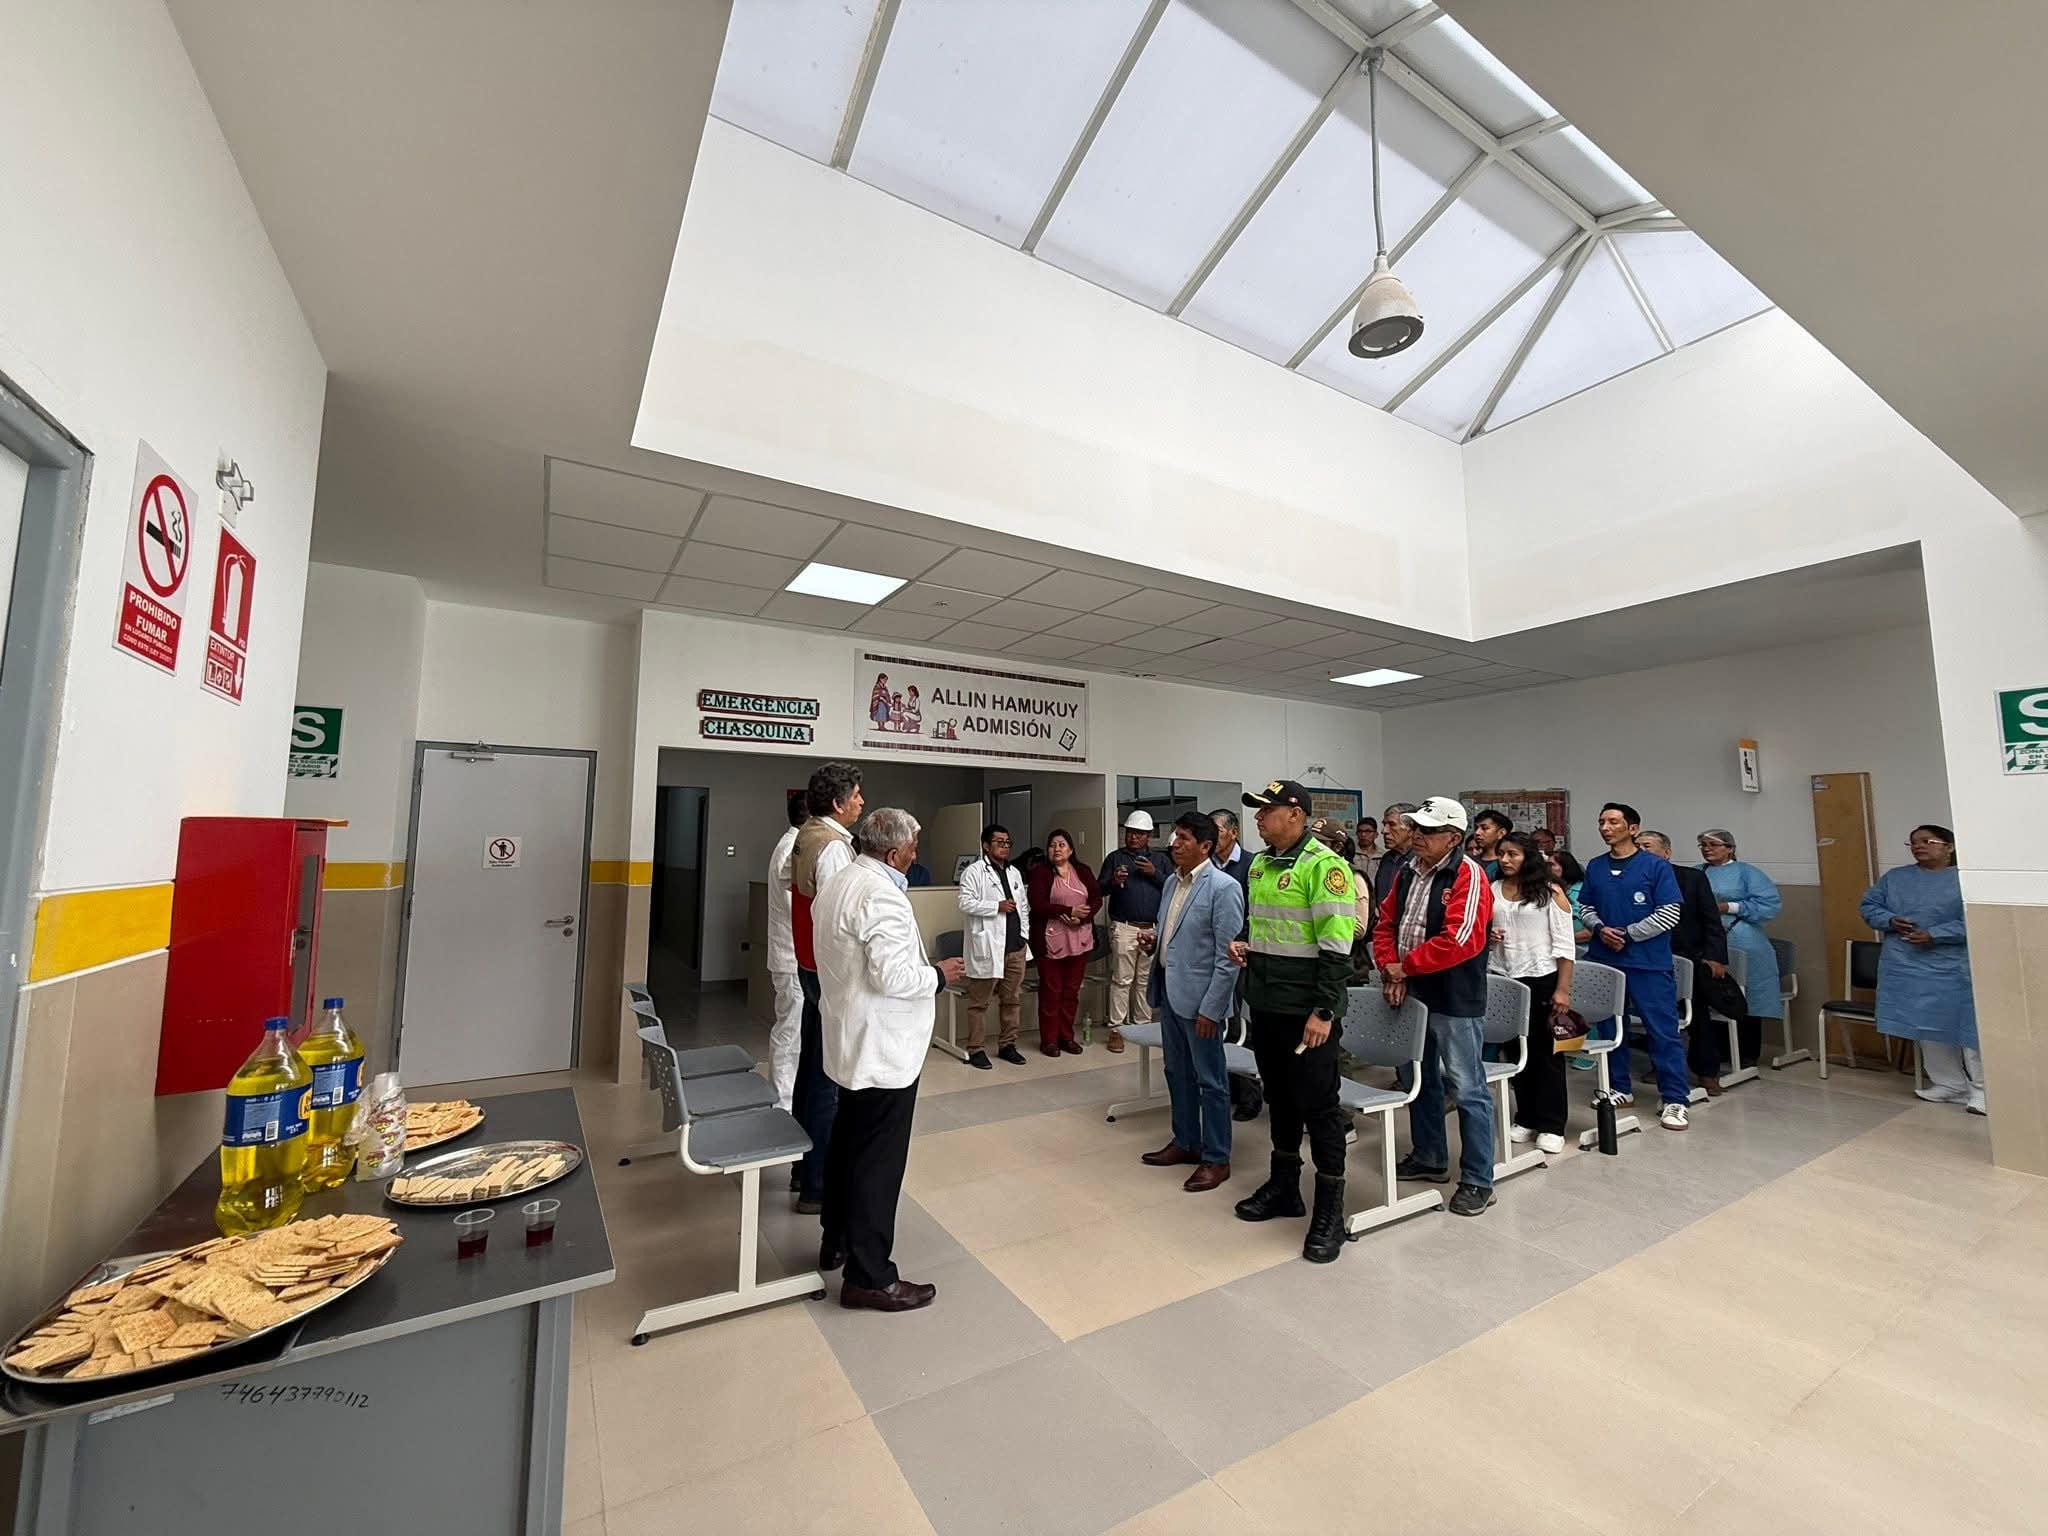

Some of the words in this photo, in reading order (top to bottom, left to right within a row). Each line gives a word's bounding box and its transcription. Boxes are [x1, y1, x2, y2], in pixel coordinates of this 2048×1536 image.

[129, 590, 178, 630] PROHIBIDO
[135, 614, 168, 643] FUMAR
[703, 693, 815, 715] EMERGENCIA
[931, 687, 987, 710] ALLIN
[992, 694, 1078, 719] HAMUKUY
[292, 711, 326, 748] S
[704, 720, 806, 740] CHASQUINA
[963, 715, 1052, 739] ADMISIÓN
